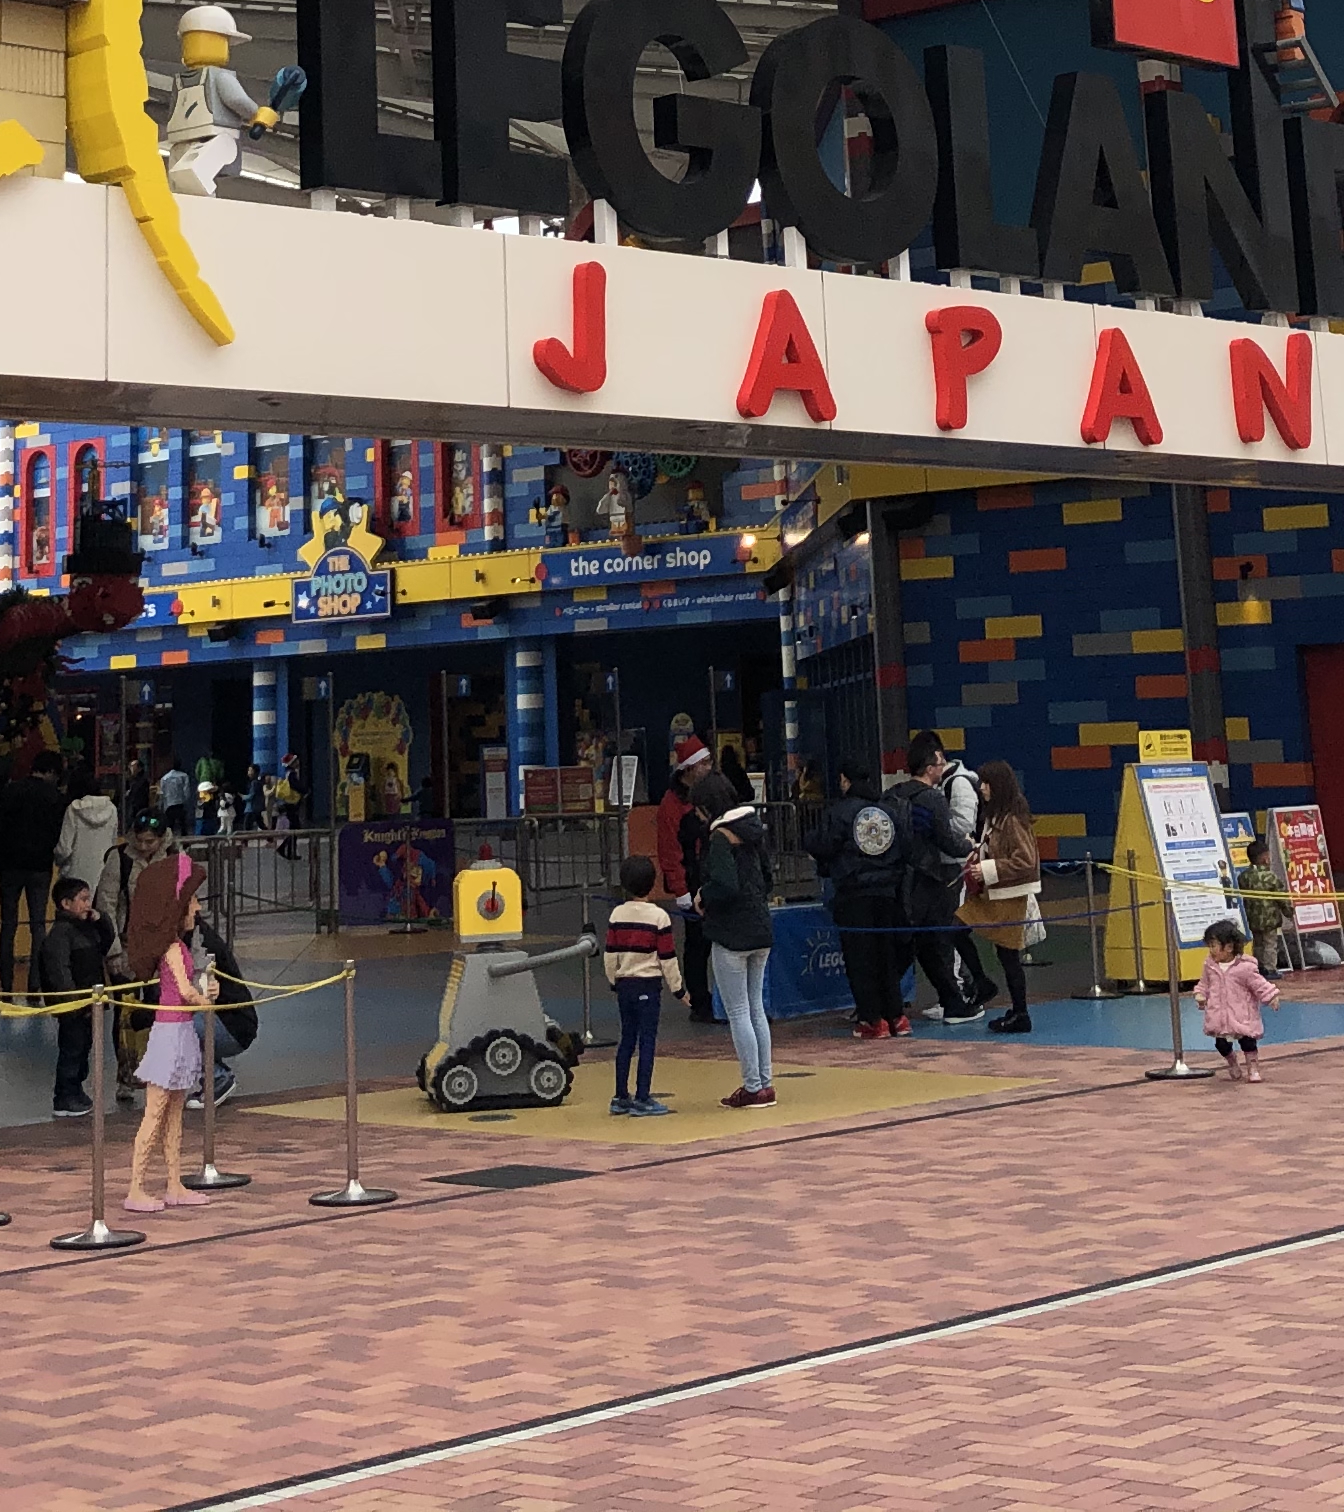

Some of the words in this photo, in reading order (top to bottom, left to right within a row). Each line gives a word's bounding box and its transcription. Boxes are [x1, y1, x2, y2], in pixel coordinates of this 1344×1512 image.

[532, 260, 1313, 450] JAPAN
[327, 555, 350, 572] THE
[570, 556, 599, 576] the
[604, 555, 661, 574] corner
[666, 547, 712, 570] shop
[311, 571, 367, 597] PHOTO
[317, 593, 361, 616] SHOP
